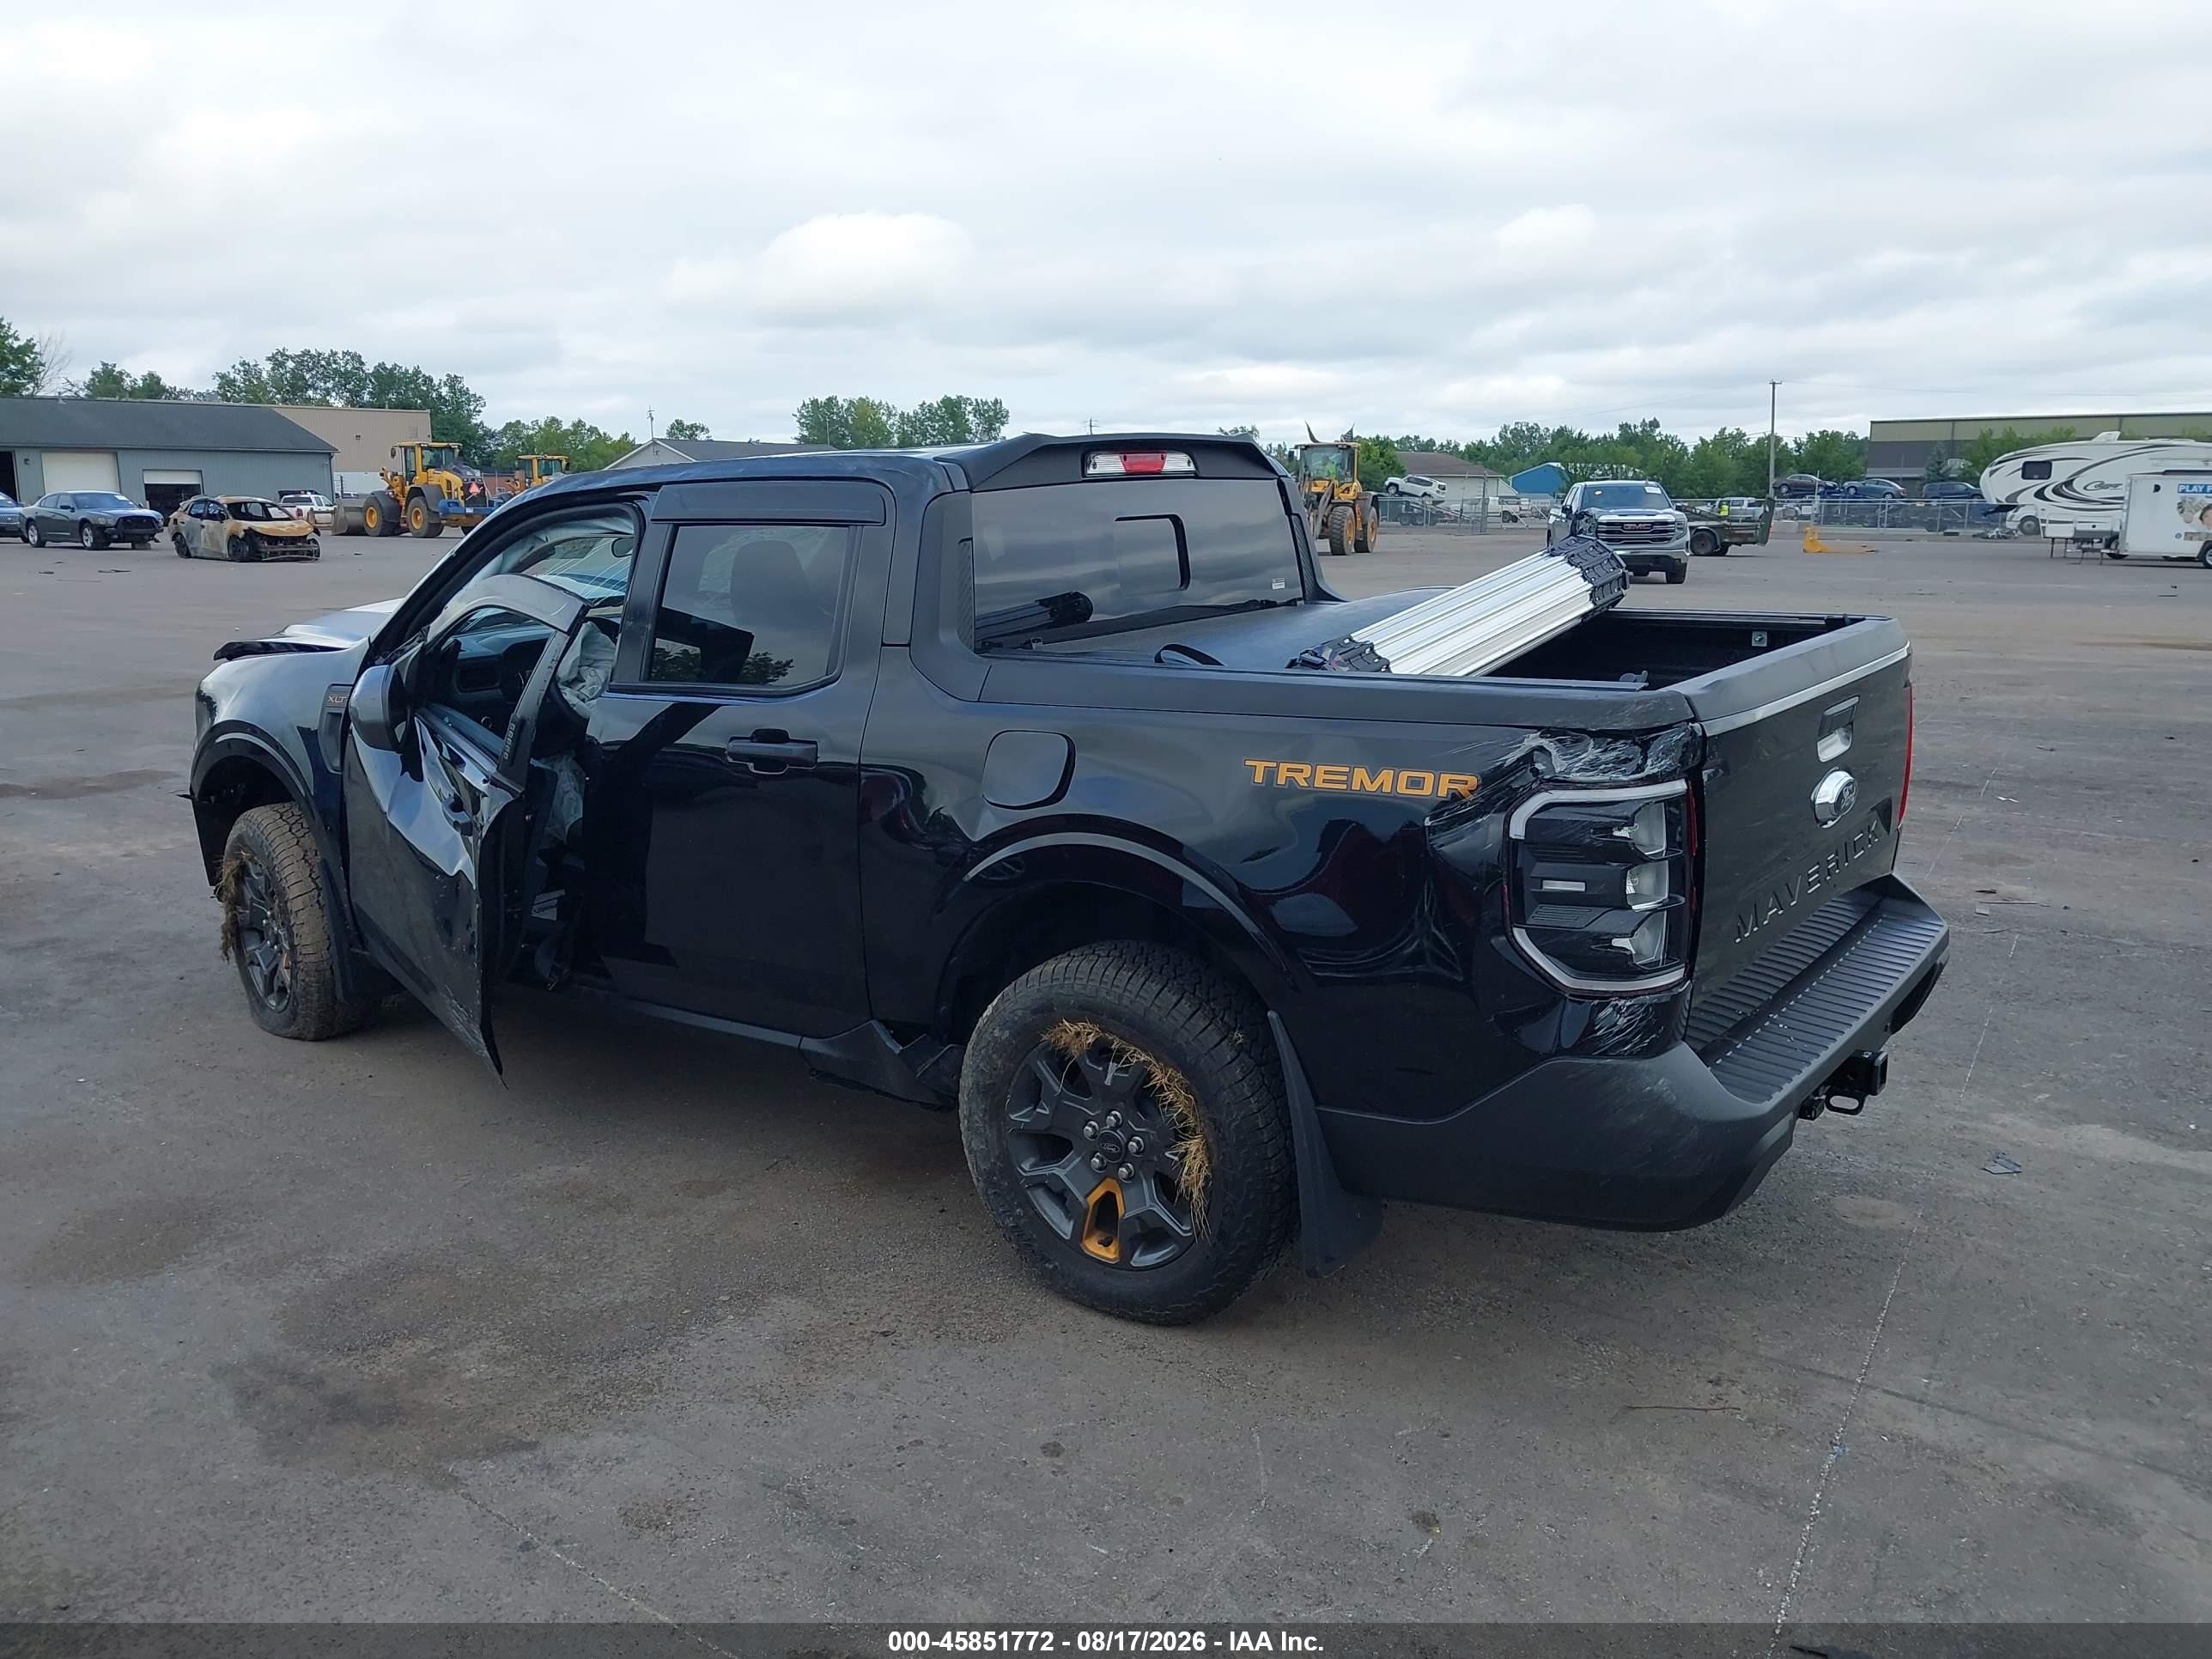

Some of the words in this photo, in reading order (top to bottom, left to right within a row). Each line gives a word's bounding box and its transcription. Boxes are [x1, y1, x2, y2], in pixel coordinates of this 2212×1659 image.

[327, 695, 349, 703] XLT
[1244, 759, 1479, 800] TREMOR
[1735, 819, 1880, 943] MAVERICK
